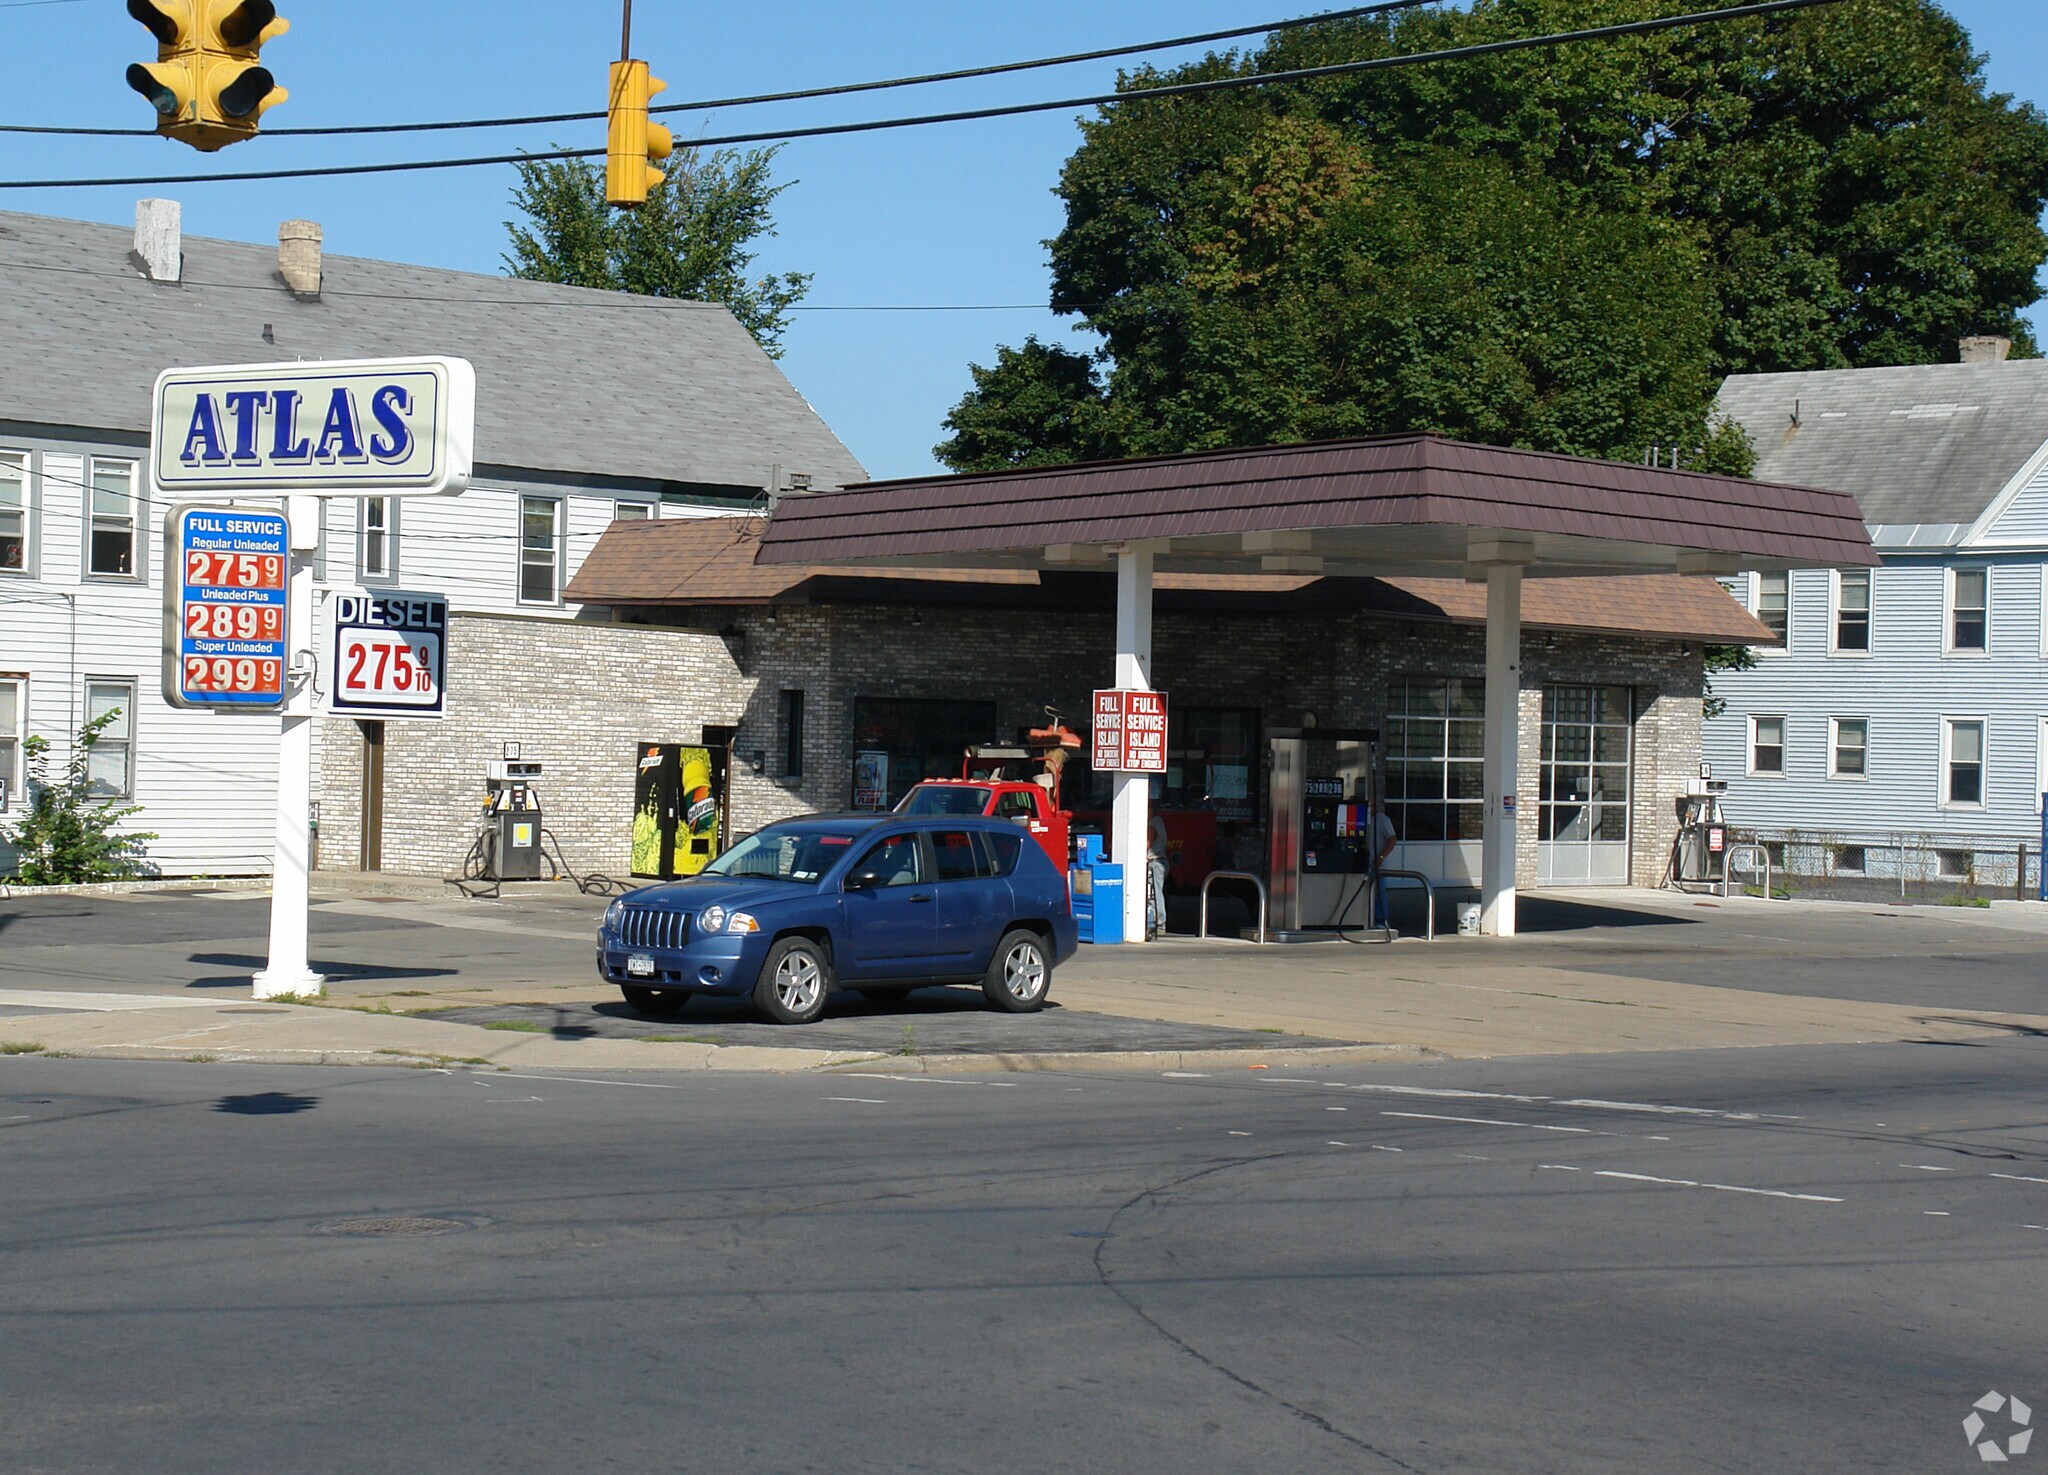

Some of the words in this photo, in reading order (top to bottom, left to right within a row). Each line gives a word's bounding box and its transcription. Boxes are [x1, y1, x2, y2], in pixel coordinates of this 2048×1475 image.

[180, 384, 413, 467] ATLAS
[189, 517, 223, 532] FULL
[226, 519, 283, 536] SERVICE
[192, 536, 232, 550] Regular
[233, 538, 279, 551] Unleaded
[201, 588, 247, 601] Unleaded
[248, 590, 270, 602] Plus
[337, 596, 443, 628] DIESEL
[194, 639, 225, 653] Super
[226, 641, 273, 653] Unleaded
[1100, 696, 1118, 712] FULL
[1132, 697, 1159, 714] FULL
[1096, 713, 1121, 729] SERVICE
[1127, 714, 1164, 731] SERVICE
[1097, 731, 1119, 746] ISLAND
[1129, 731, 1160, 747] ISLAND
